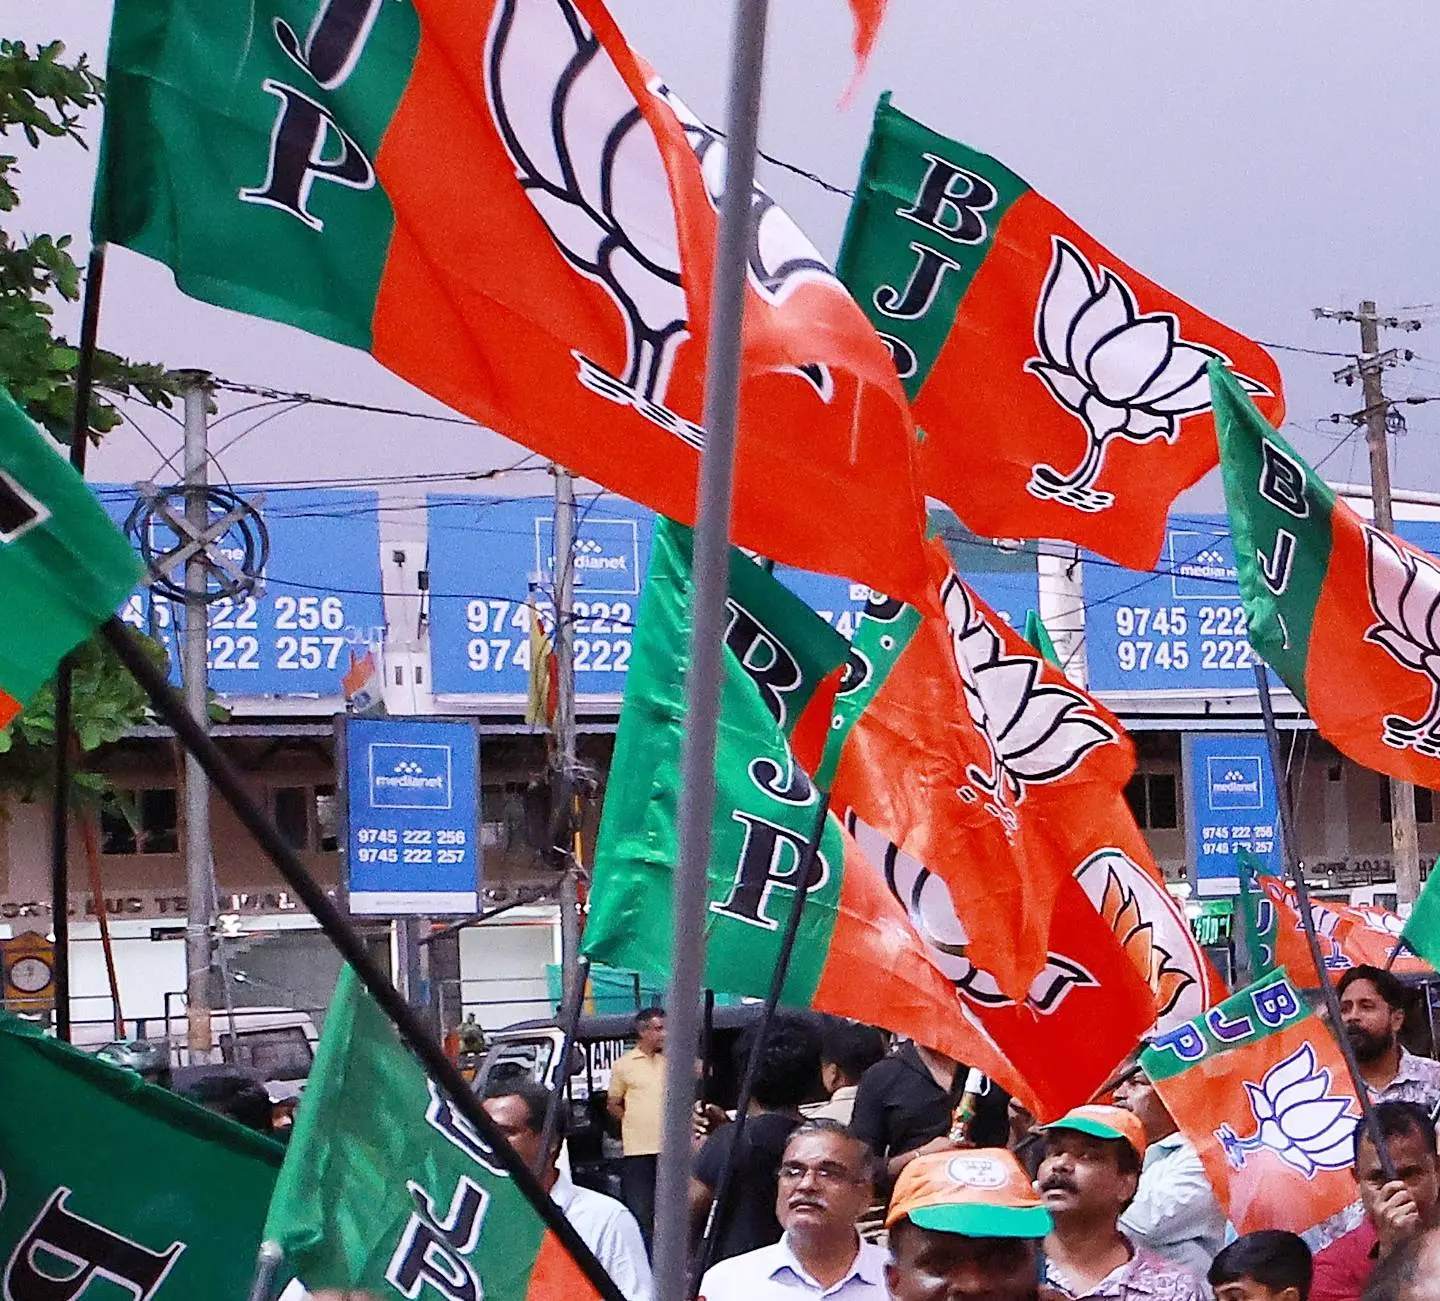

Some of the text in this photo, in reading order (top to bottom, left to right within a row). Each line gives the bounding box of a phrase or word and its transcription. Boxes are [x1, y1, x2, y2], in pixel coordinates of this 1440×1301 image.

[206, 597, 258, 630] 22
[274, 597, 345, 630] 256
[572, 602, 633, 634] 222
[1115, 606, 1249, 637] 9745 222
[206, 637, 260, 670] 22
[276, 637, 344, 670] 257
[467, 638, 633, 672] 974 222
[1118, 640, 1252, 671] 9745 222
[375, 775, 443, 788] medianet
[1212, 781, 1258, 792] medianet
[358, 829, 466, 845] 9745 222 256
[1202, 826, 1229, 839] 9745
[1231, 826, 1251, 839] 222
[1254, 841, 1273, 854] 257
[358, 849, 466, 864] 9745 222 257
[1149, 979, 1300, 1062] BJP
